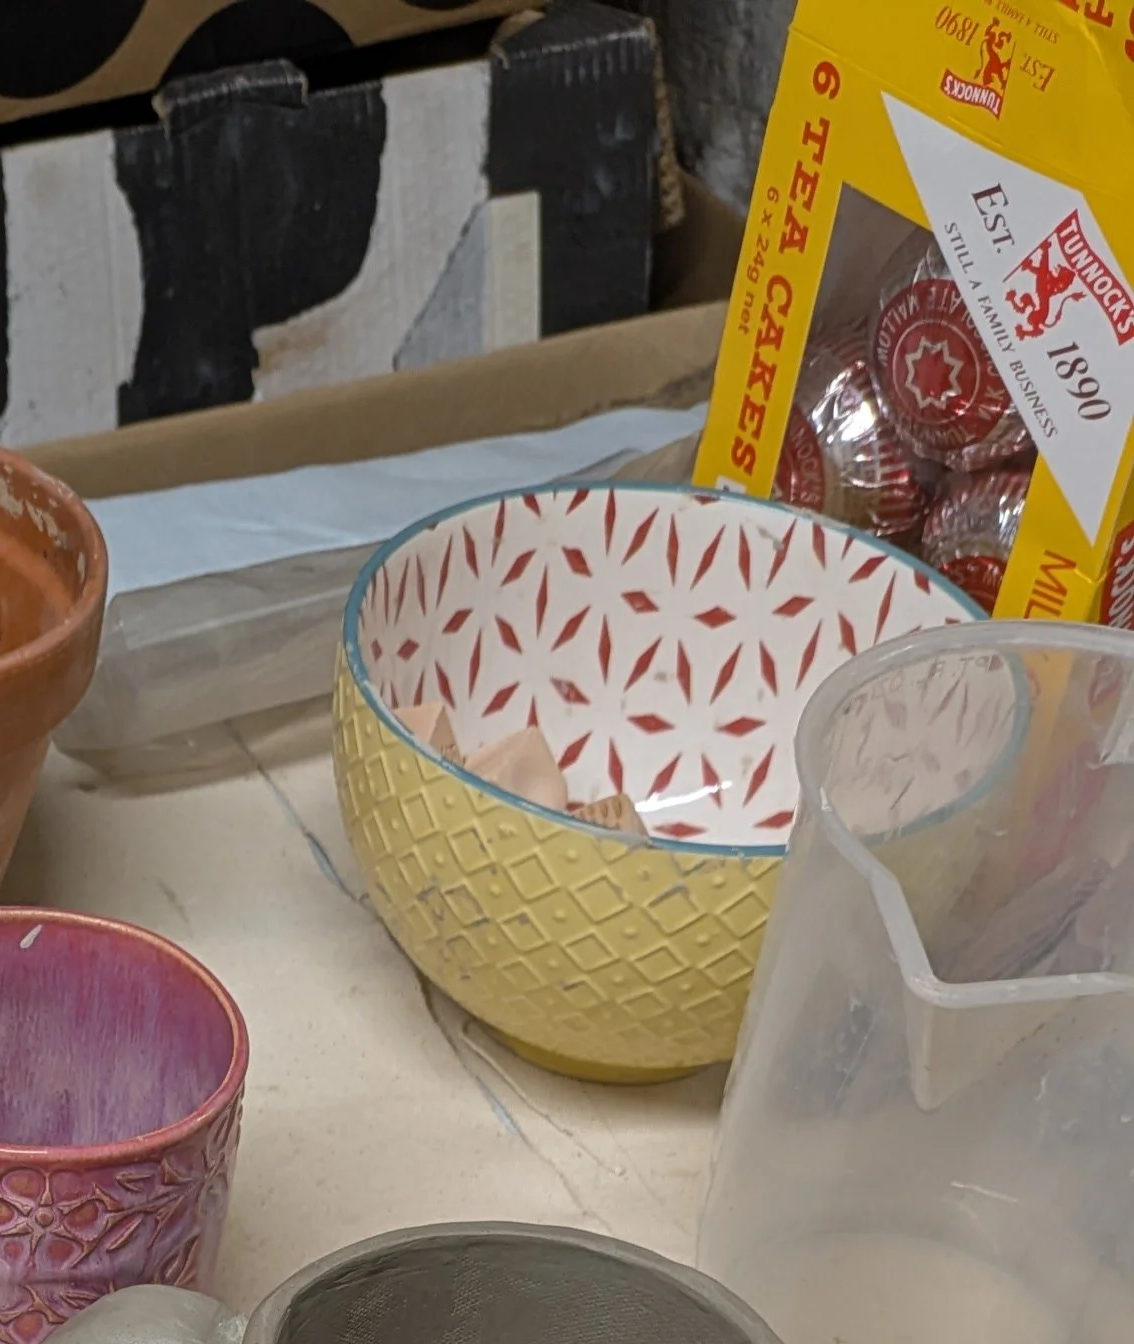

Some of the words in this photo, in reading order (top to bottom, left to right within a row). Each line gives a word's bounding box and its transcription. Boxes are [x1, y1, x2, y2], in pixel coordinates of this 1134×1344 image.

[935, 5, 979, 46] 1890
[813, 61, 840, 100] 6
[944, 75, 1002, 115] TUNNOCK'S
[767, 187, 779, 203] 6
[778, 116, 830, 254] TEA
[746, 233, 769, 285] 24g
[1060, 219, 1134, 334] TUNNOCK'S
[738, 291, 755, 335] net
[944, 222, 974, 274] STILL
[969, 279, 983, 290] A
[978, 296, 1016, 352] FAMILY
[1009, 361, 1058, 438] BUSINESS
[971, 183, 1016, 254] EST.
[1047, 341, 1112, 421] 1890
[731, 274, 793, 476] CAKES
[1023, 550, 1077, 619] MIL
